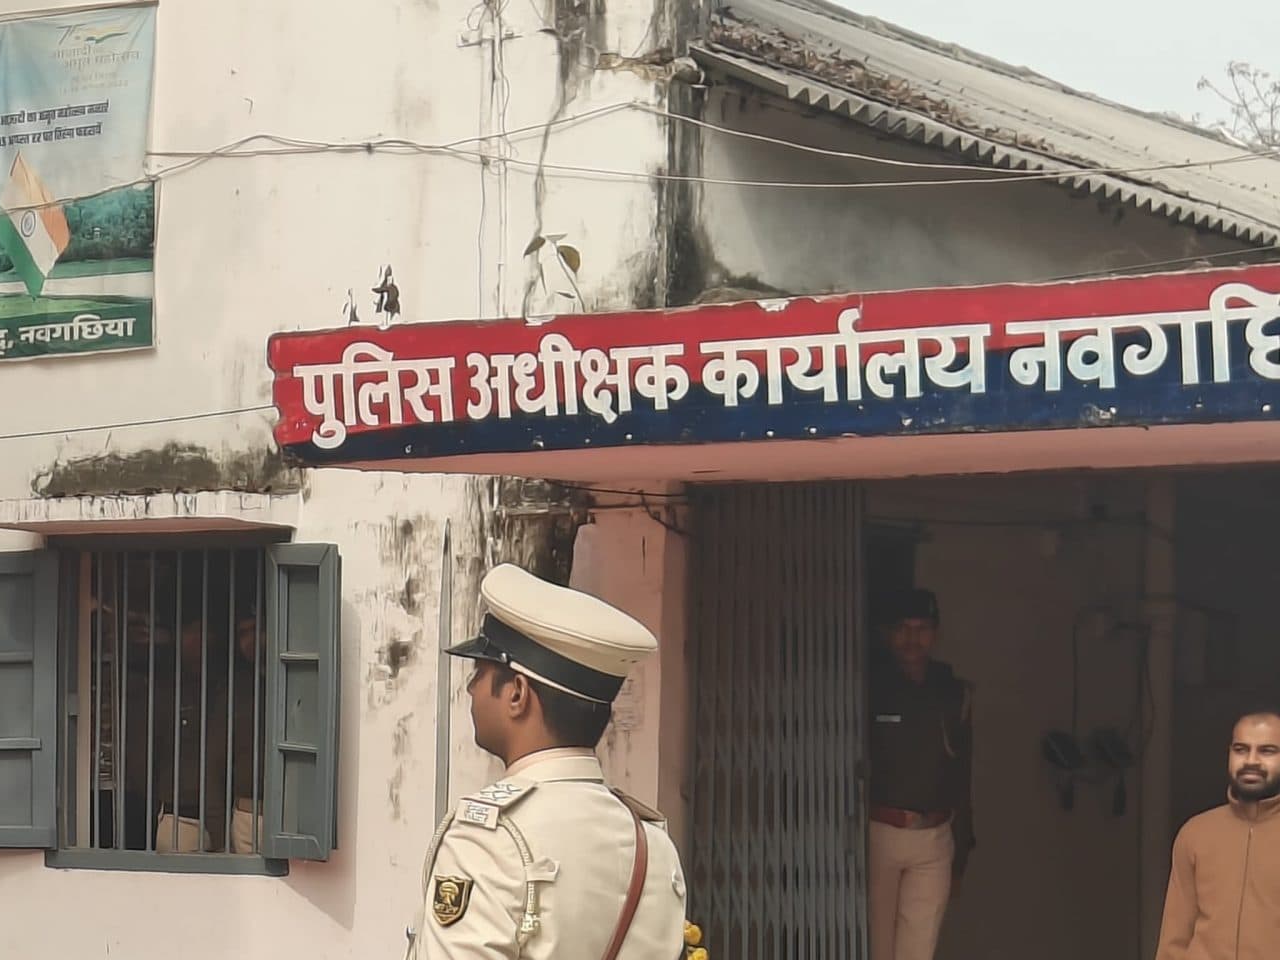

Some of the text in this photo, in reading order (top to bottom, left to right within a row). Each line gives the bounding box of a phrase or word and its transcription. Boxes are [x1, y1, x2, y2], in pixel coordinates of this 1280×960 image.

[18, 313, 136, 344] नवगछिया
[293, 341, 455, 450] पुलिस
[465, 333, 689, 424] अधीक्षक
[699, 308, 992, 407] कार्यालय
